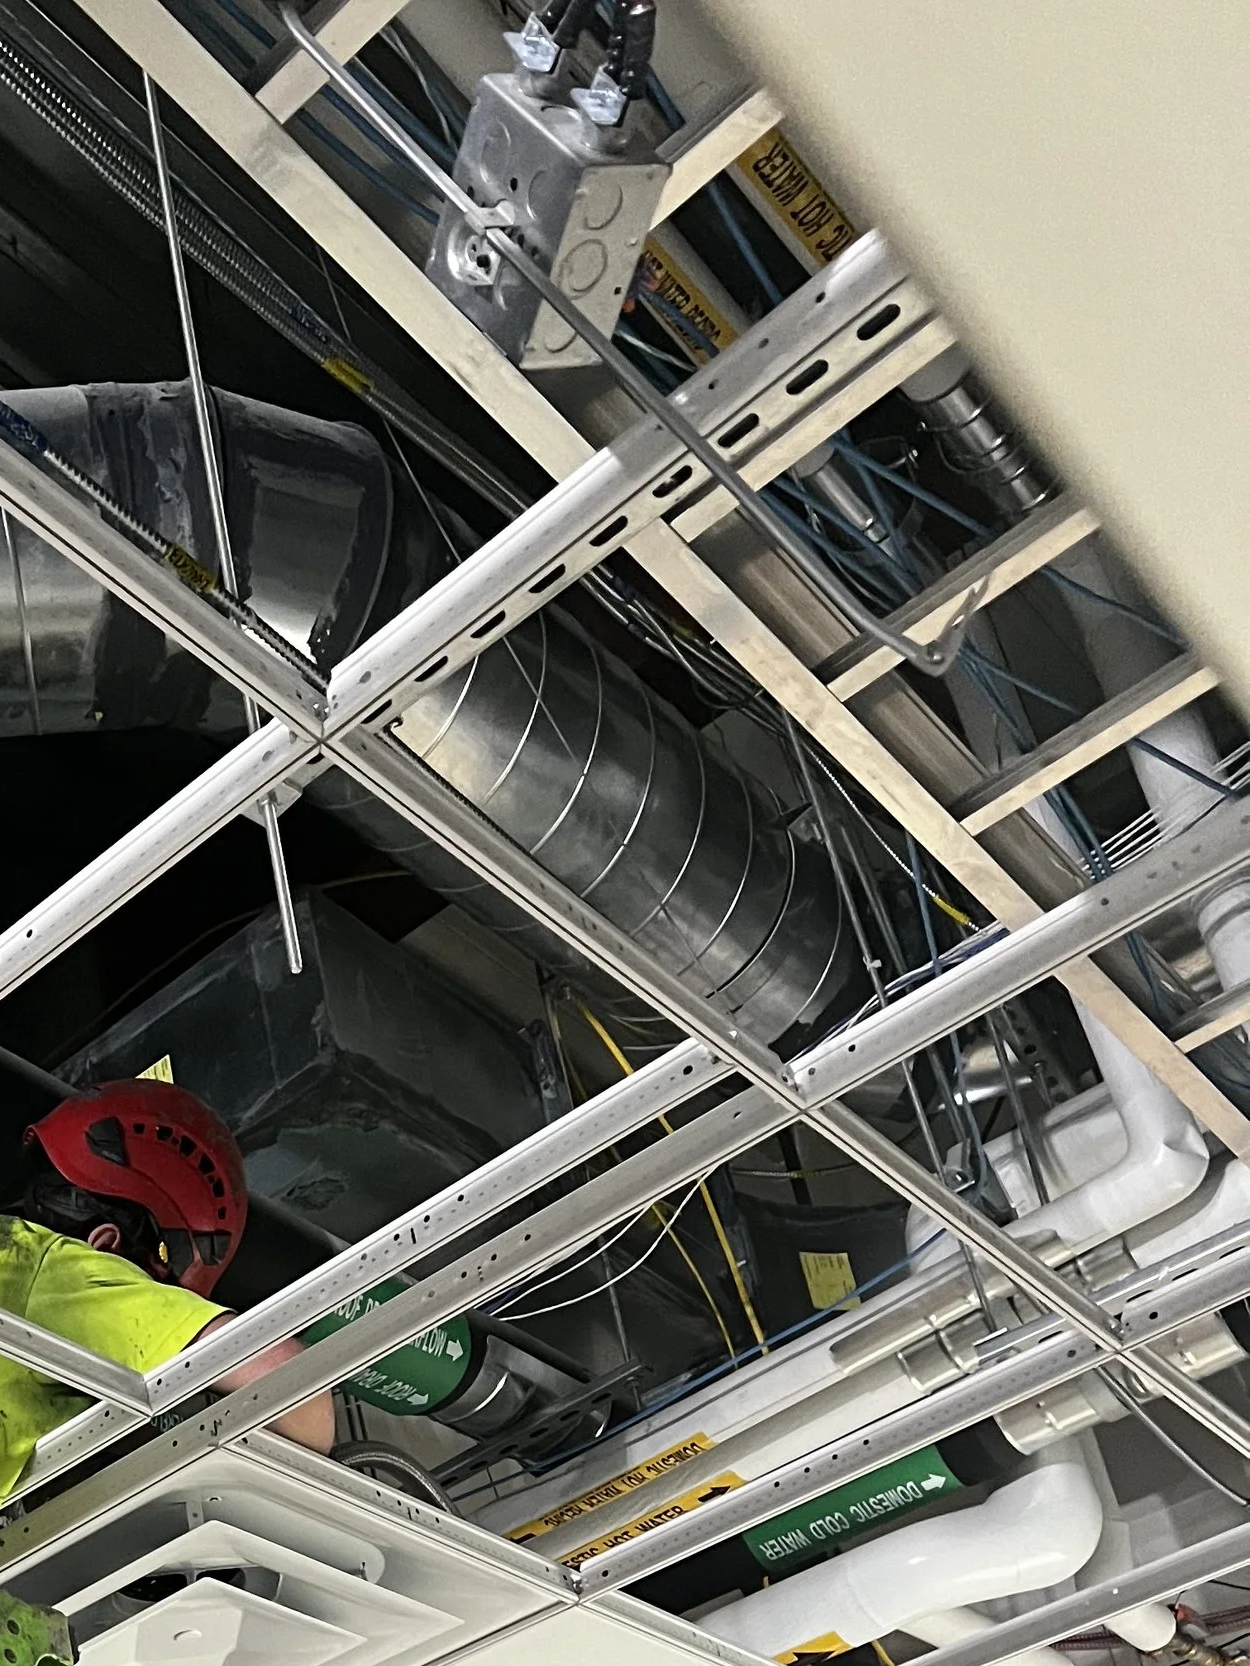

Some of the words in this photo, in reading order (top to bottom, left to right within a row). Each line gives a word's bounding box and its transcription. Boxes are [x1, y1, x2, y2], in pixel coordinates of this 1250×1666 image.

[752, 142, 809, 207] WATER
[790, 193, 835, 237] HOT
[334, 1294, 364, 1321] OOF
[374, 1380, 417, 1401] ROOF
[645, 1442, 706, 1477] DOMESTIC
[849, 1481, 924, 1523] DOMESTIC
[634, 1505, 686, 1532] WATER
[809, 1511, 850, 1540] COLD
[758, 1528, 812, 1560] WATER
